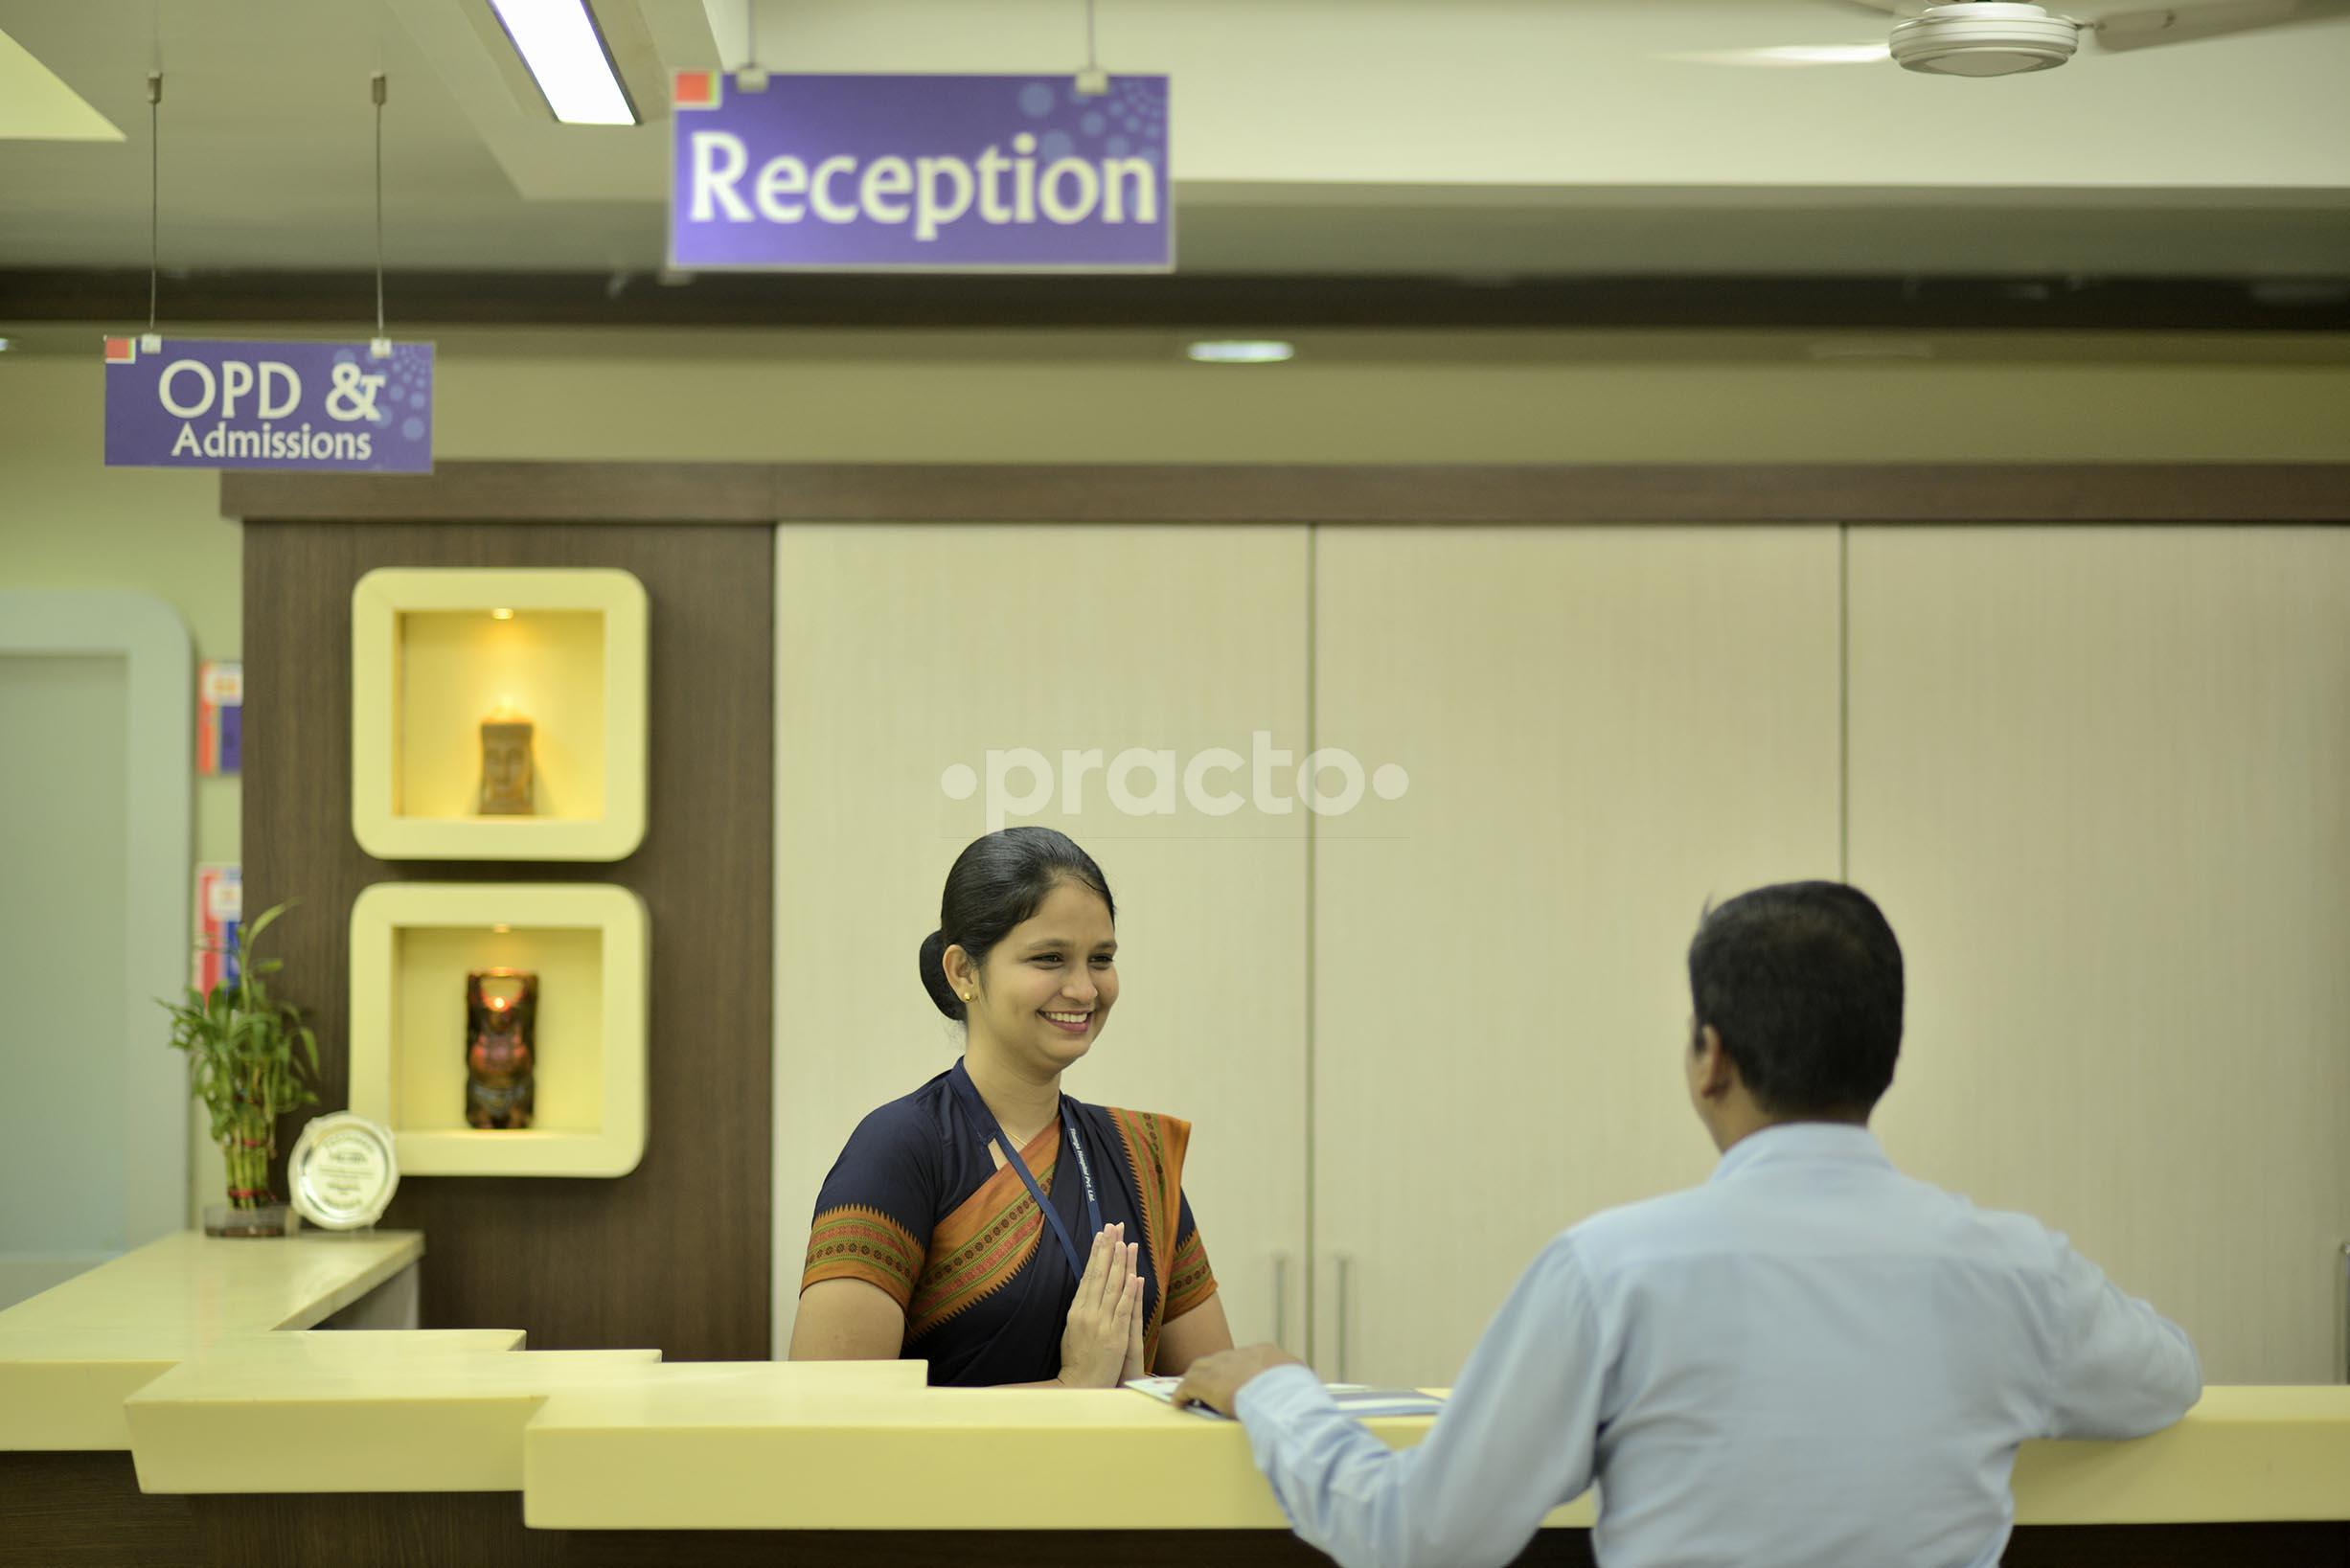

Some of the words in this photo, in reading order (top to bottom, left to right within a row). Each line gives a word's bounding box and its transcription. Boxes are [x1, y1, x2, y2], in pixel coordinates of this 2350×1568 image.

[689, 130, 1157, 241] Reception
[158, 359, 302, 420] OPD
[325, 362, 386, 421] &
[171, 421, 373, 461] Admissions
